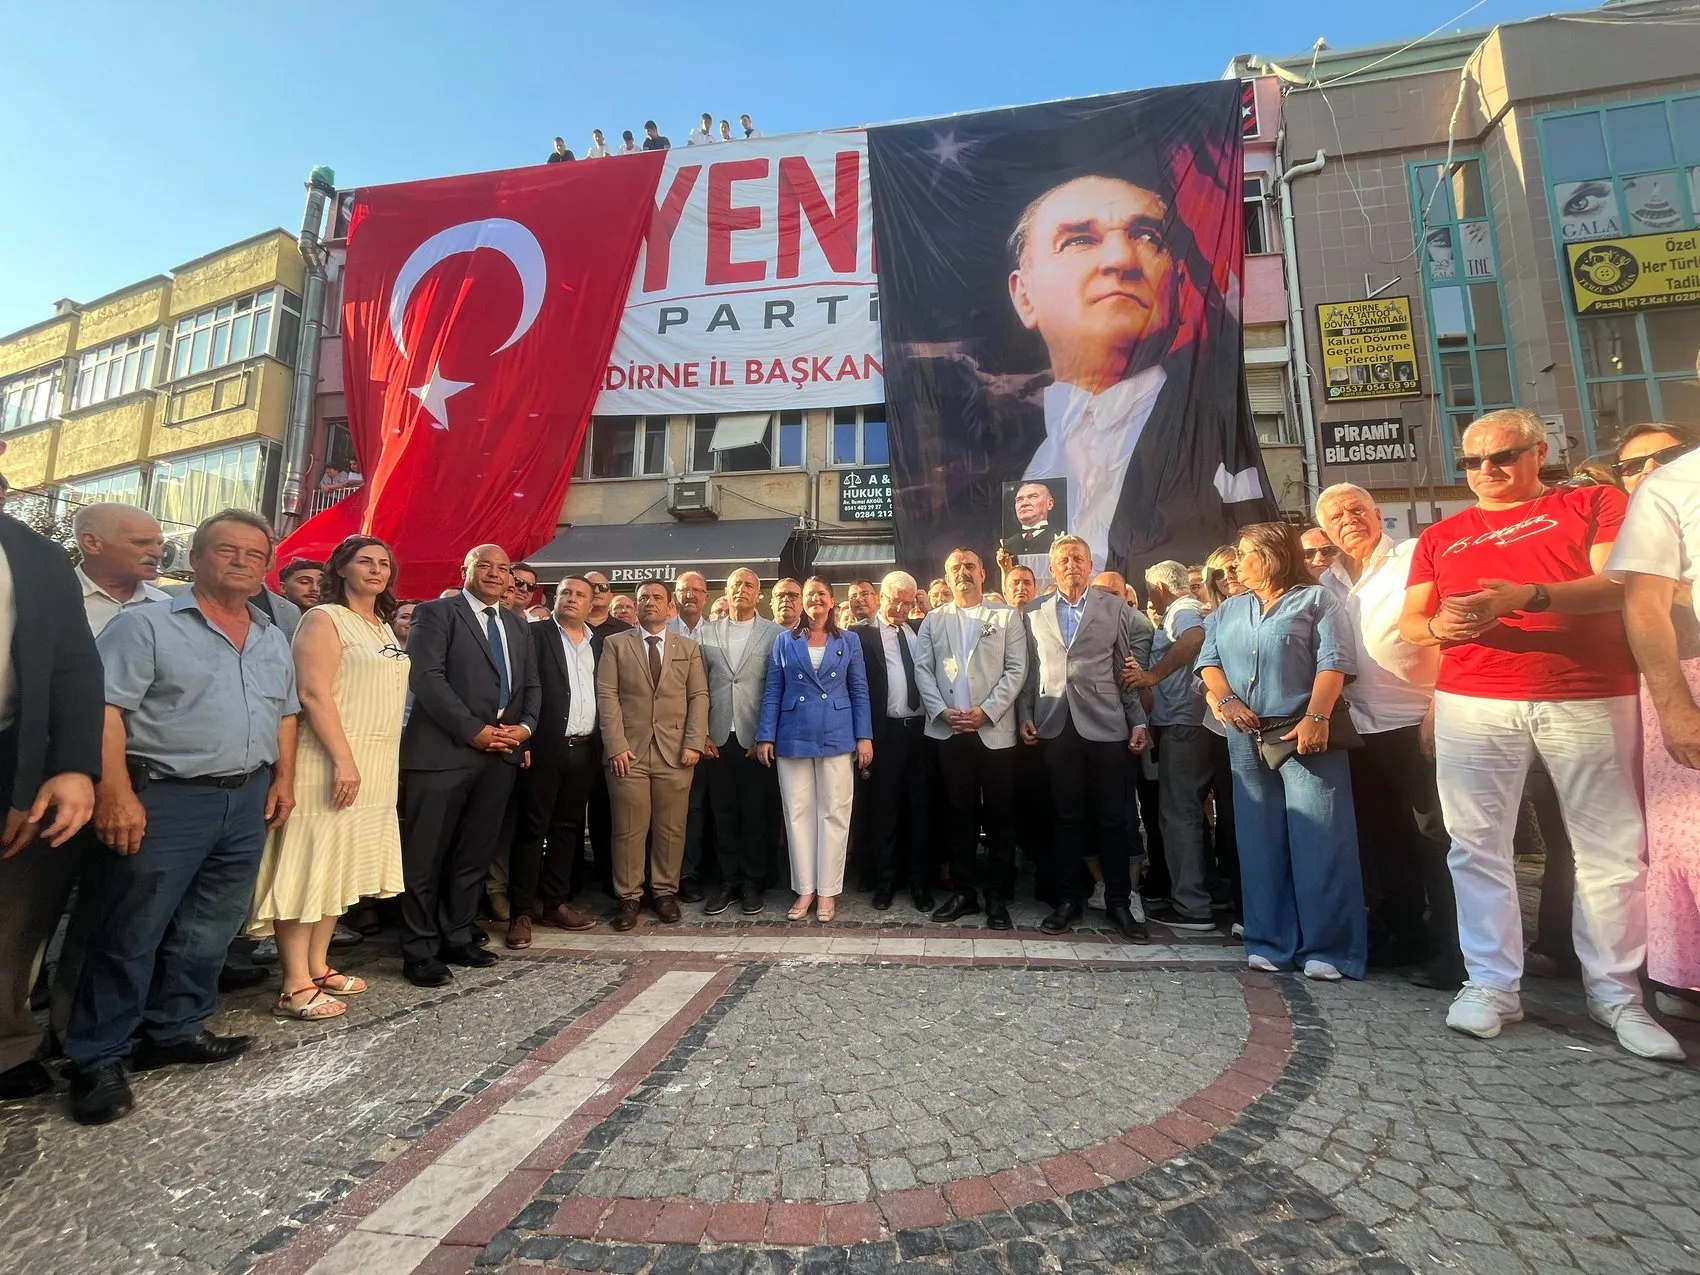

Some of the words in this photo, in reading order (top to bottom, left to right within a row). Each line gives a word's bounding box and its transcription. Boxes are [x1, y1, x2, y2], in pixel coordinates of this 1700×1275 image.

[1562, 217, 1618, 238] GALA
[1665, 237, 1697, 252] Özel
[1642, 261, 1667, 274] Her
[1347, 303, 1379, 314] EDİRNE
[1595, 299, 1623, 310] Pasaj
[657, 292, 879, 335] PARTİ
[1340, 312, 1354, 321] TAZ
[1357, 309, 1391, 319] TATTOO
[1324, 319, 1357, 329] DÖVME
[1359, 315, 1407, 326] SANATLARI
[1328, 336, 1360, 346] Kalıcı
[1363, 333, 1407, 344] Dövme
[1326, 346, 1363, 356] Geçici
[1366, 343, 1410, 353] Dövme
[1345, 354, 1394, 364] Piercing
[709, 355, 734, 386] İL
[1340, 385, 1363, 393] 0537
[1367, 383, 1386, 391] 054
[1334, 421, 1400, 442] PİRAMİT
[1325, 443, 1416, 463] BİLGİSAYAR
[868, 474, 878, 485] A
[881, 474, 891, 484] &
[843, 488, 883, 498] HUKUK
[854, 511, 875, 519] 0284
[611, 564, 677, 582] PRESTİJ
